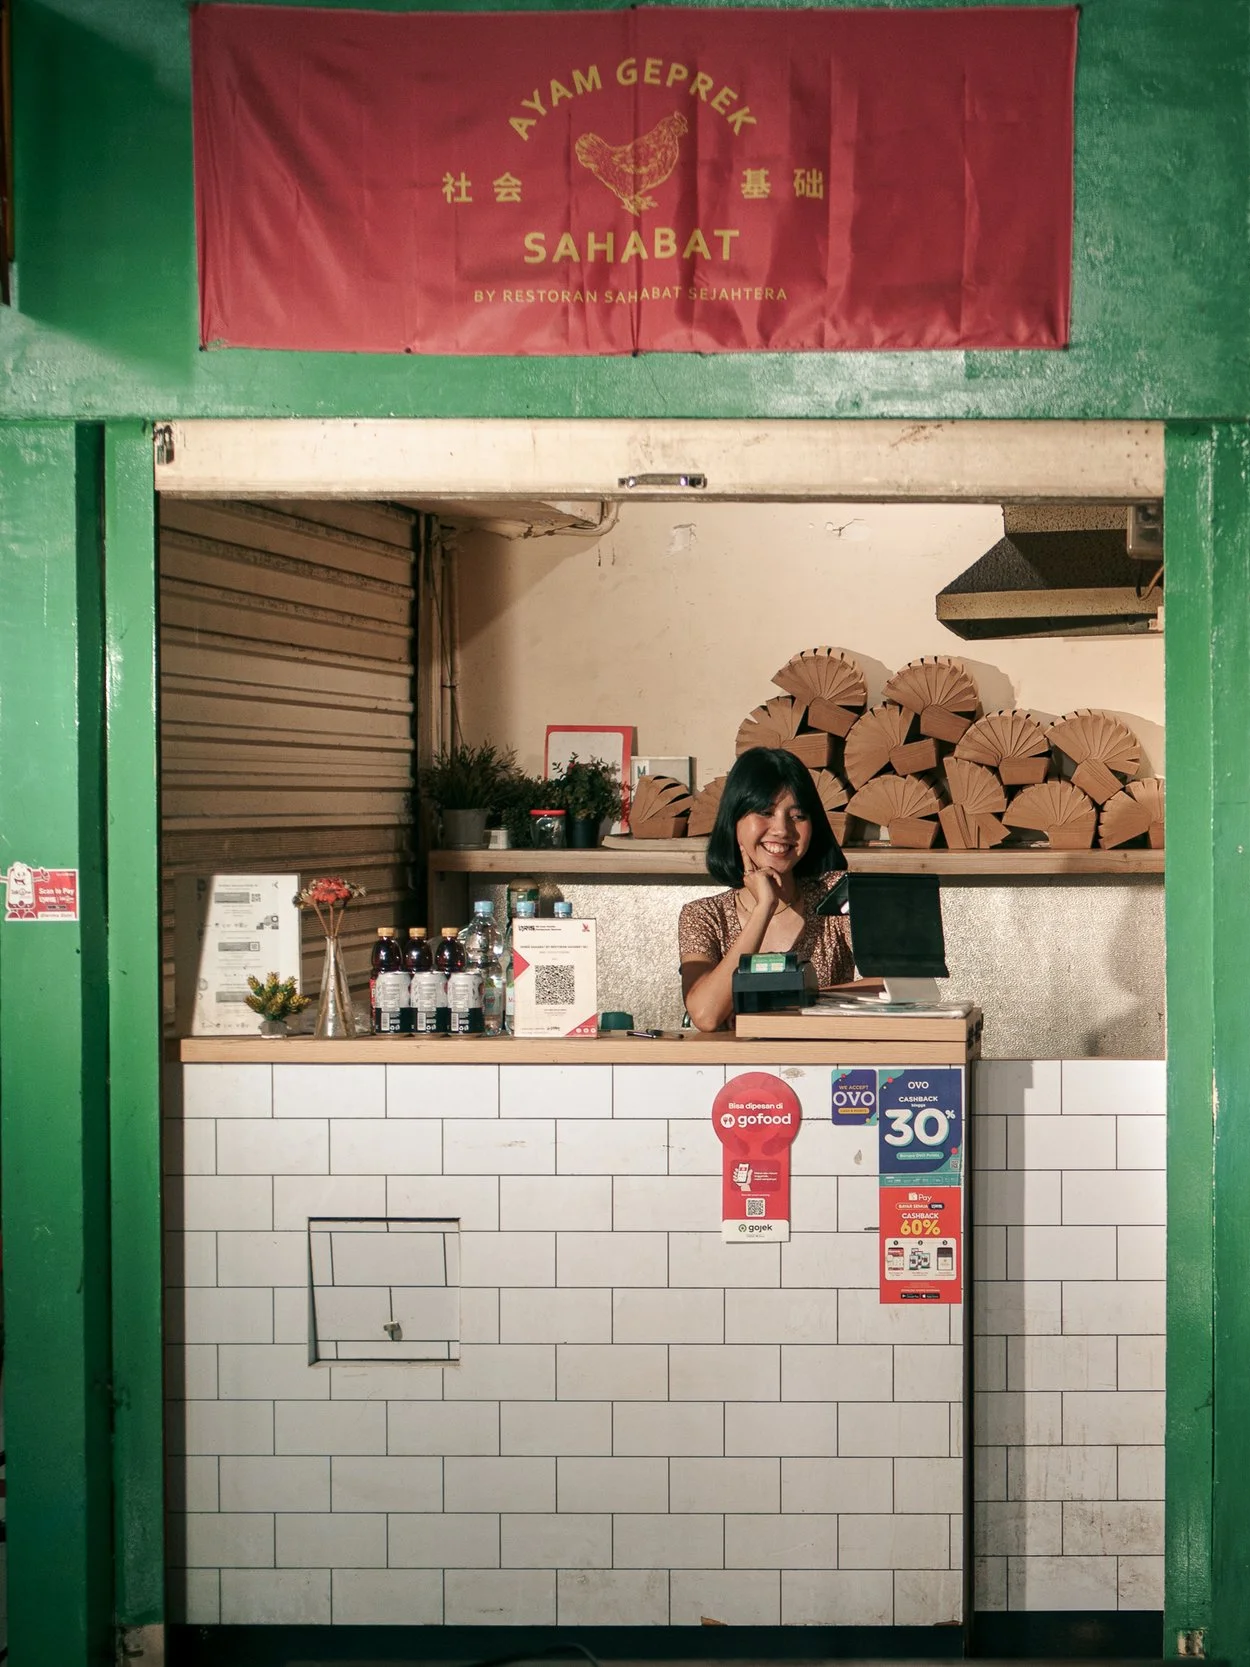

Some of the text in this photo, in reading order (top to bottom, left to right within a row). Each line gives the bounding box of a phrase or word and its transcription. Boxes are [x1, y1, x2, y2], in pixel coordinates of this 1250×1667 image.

[509, 57, 758, 141] AYAM GEPREK
[523, 227, 740, 265] SAHABAT
[474, 285, 788, 304] BY RESTORAN SAHABAT SEJAHTERA
[907, 1081, 929, 1089] OVO
[832, 1091, 875, 1106] OVO
[898, 1095, 938, 1103] CASHBACK
[728, 1102, 783, 1111] Bisa dipesan di
[737, 1113, 792, 1129] gofood
[918, 1193, 932, 1203] Pay
[748, 1224, 773, 1234] gojek
[900, 1220, 941, 1235] 60%
